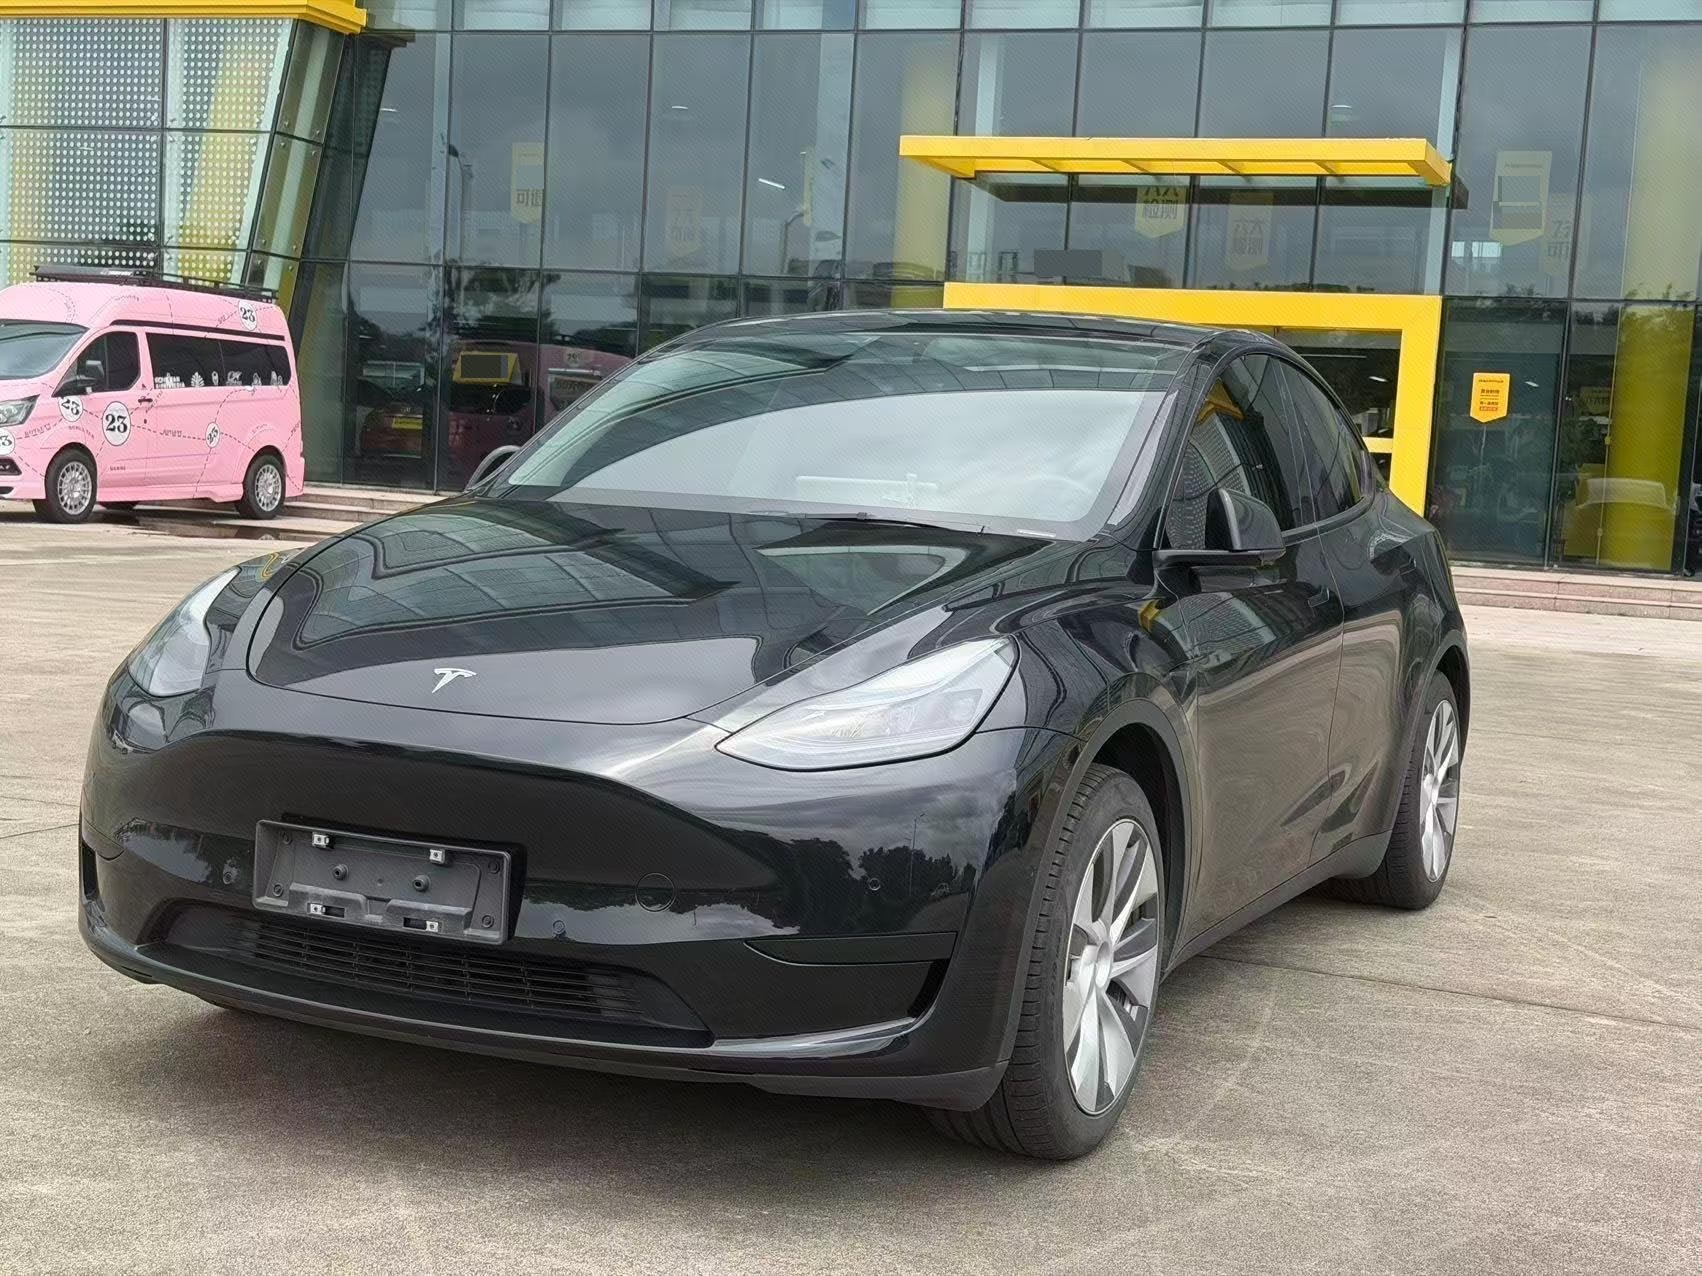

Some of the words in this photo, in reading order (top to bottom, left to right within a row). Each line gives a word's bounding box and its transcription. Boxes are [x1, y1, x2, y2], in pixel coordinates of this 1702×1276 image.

[239, 306, 256, 323] 23
[61, 395, 80, 416] 23
[105, 413, 128, 434] 23
[0, 434, 12, 447] 3
